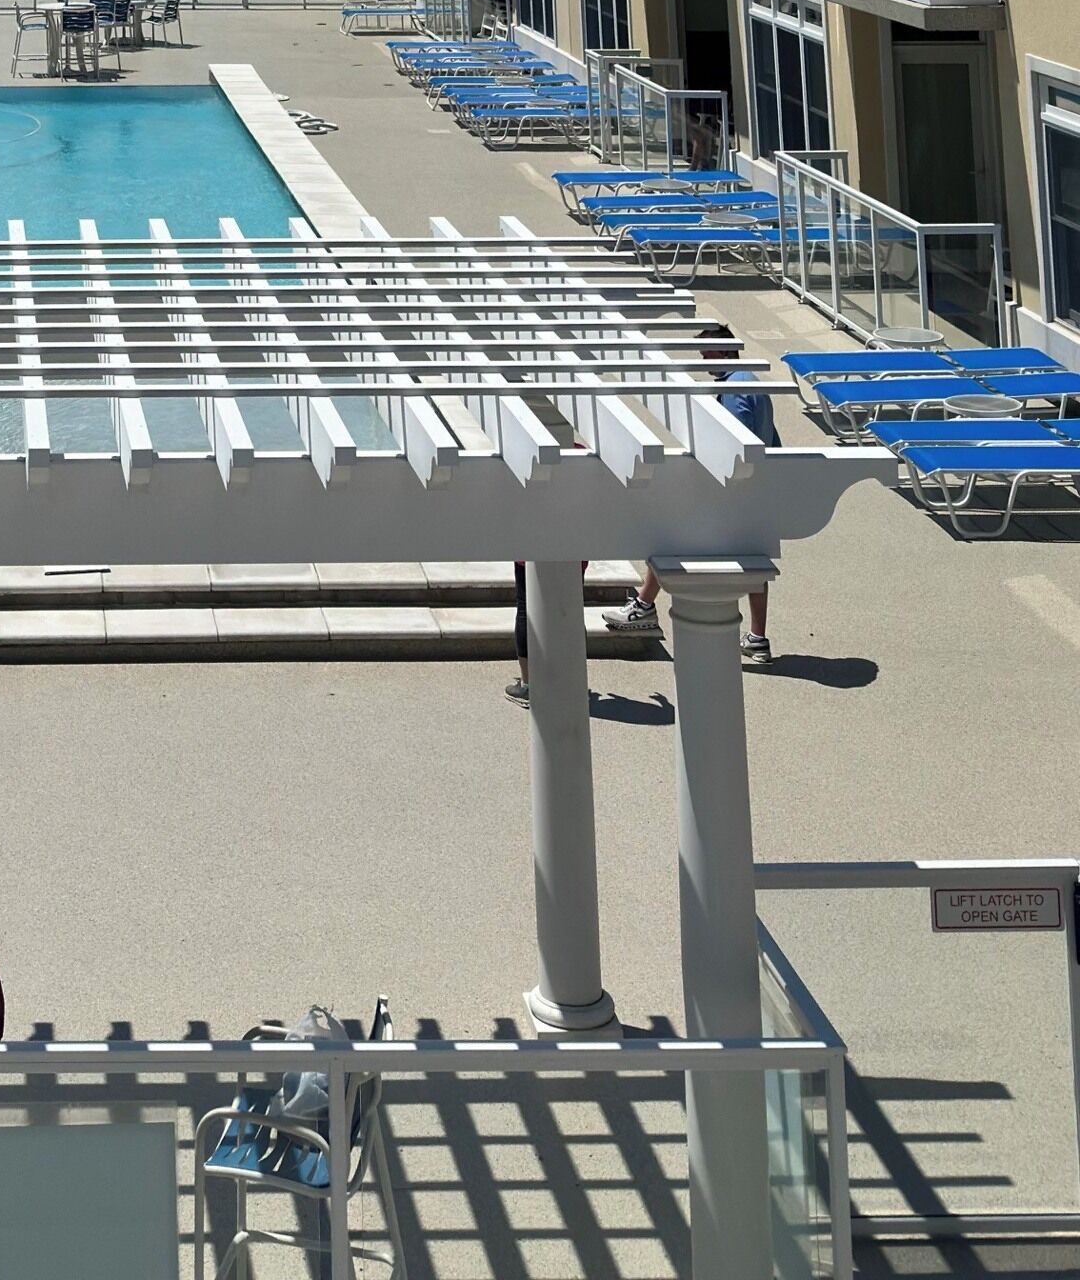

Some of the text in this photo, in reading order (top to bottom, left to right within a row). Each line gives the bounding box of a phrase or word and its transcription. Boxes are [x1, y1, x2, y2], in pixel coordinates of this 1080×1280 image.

[950, 894, 1044, 907] LIFT LATCH TO
[961, 910, 1039, 922] OPEN GATE
